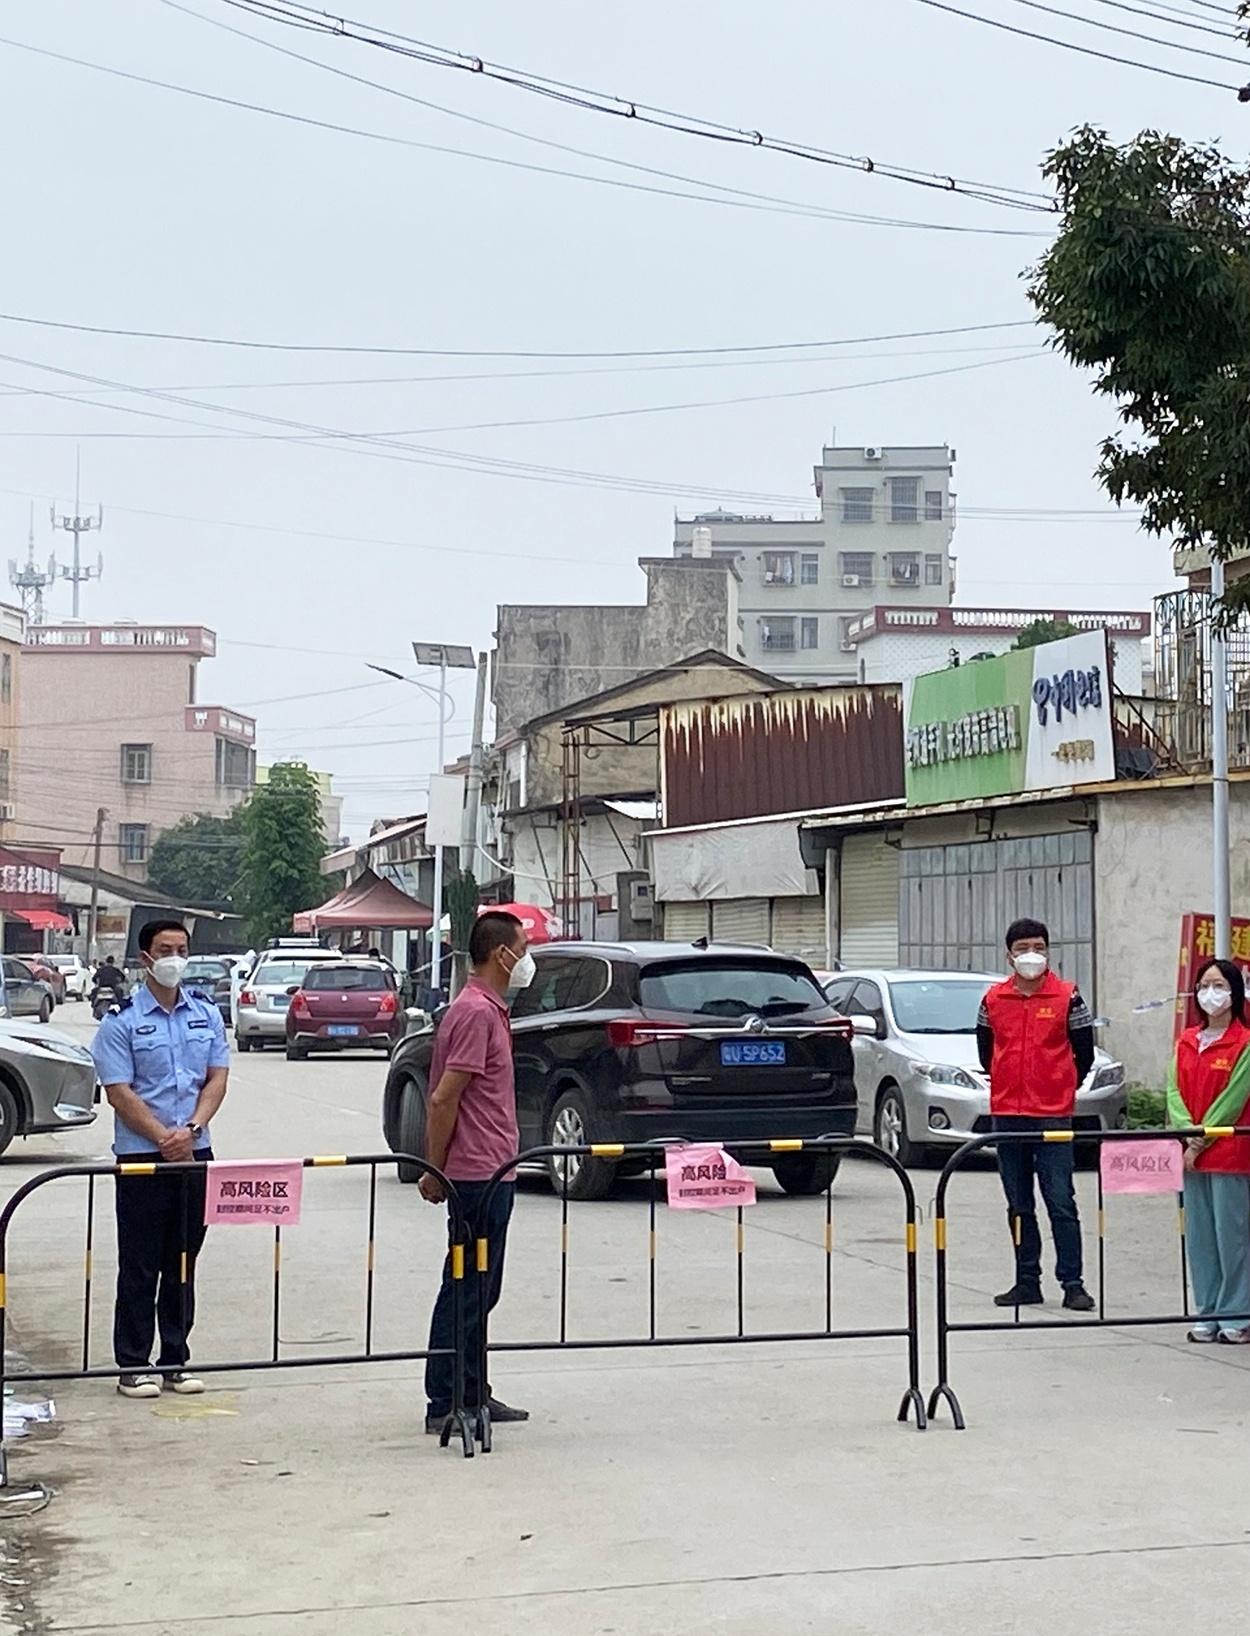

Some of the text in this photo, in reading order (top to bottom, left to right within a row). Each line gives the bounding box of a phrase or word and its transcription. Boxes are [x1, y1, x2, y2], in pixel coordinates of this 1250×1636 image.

[1110, 1155, 1172, 1173] 高风险区
[220, 1181, 289, 1198] 高风险区
